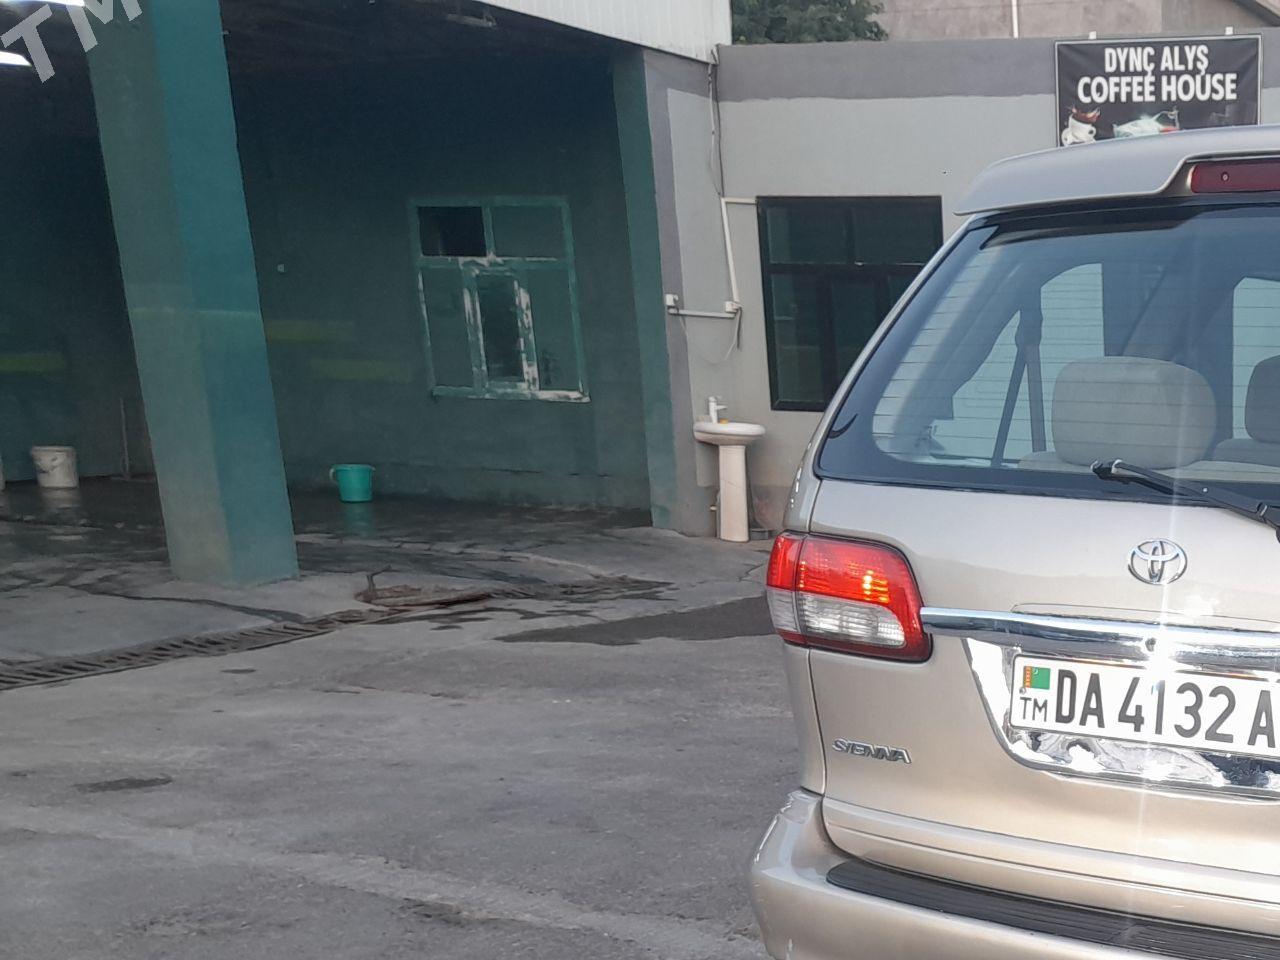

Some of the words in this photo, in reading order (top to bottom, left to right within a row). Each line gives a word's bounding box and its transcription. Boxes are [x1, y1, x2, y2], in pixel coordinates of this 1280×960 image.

[1104, 47, 1155, 76] DYNÇ
[1160, 45, 1209, 75] ALYŞ
[1077, 75, 1155, 103] COFFEE
[1161, 73, 1237, 101] HOUSE
[1020, 697, 1048, 722] TM
[1054, 669, 1105, 728] DA
[1117, 676, 1236, 744] 4132
[832, 738, 912, 764] SIENNA
